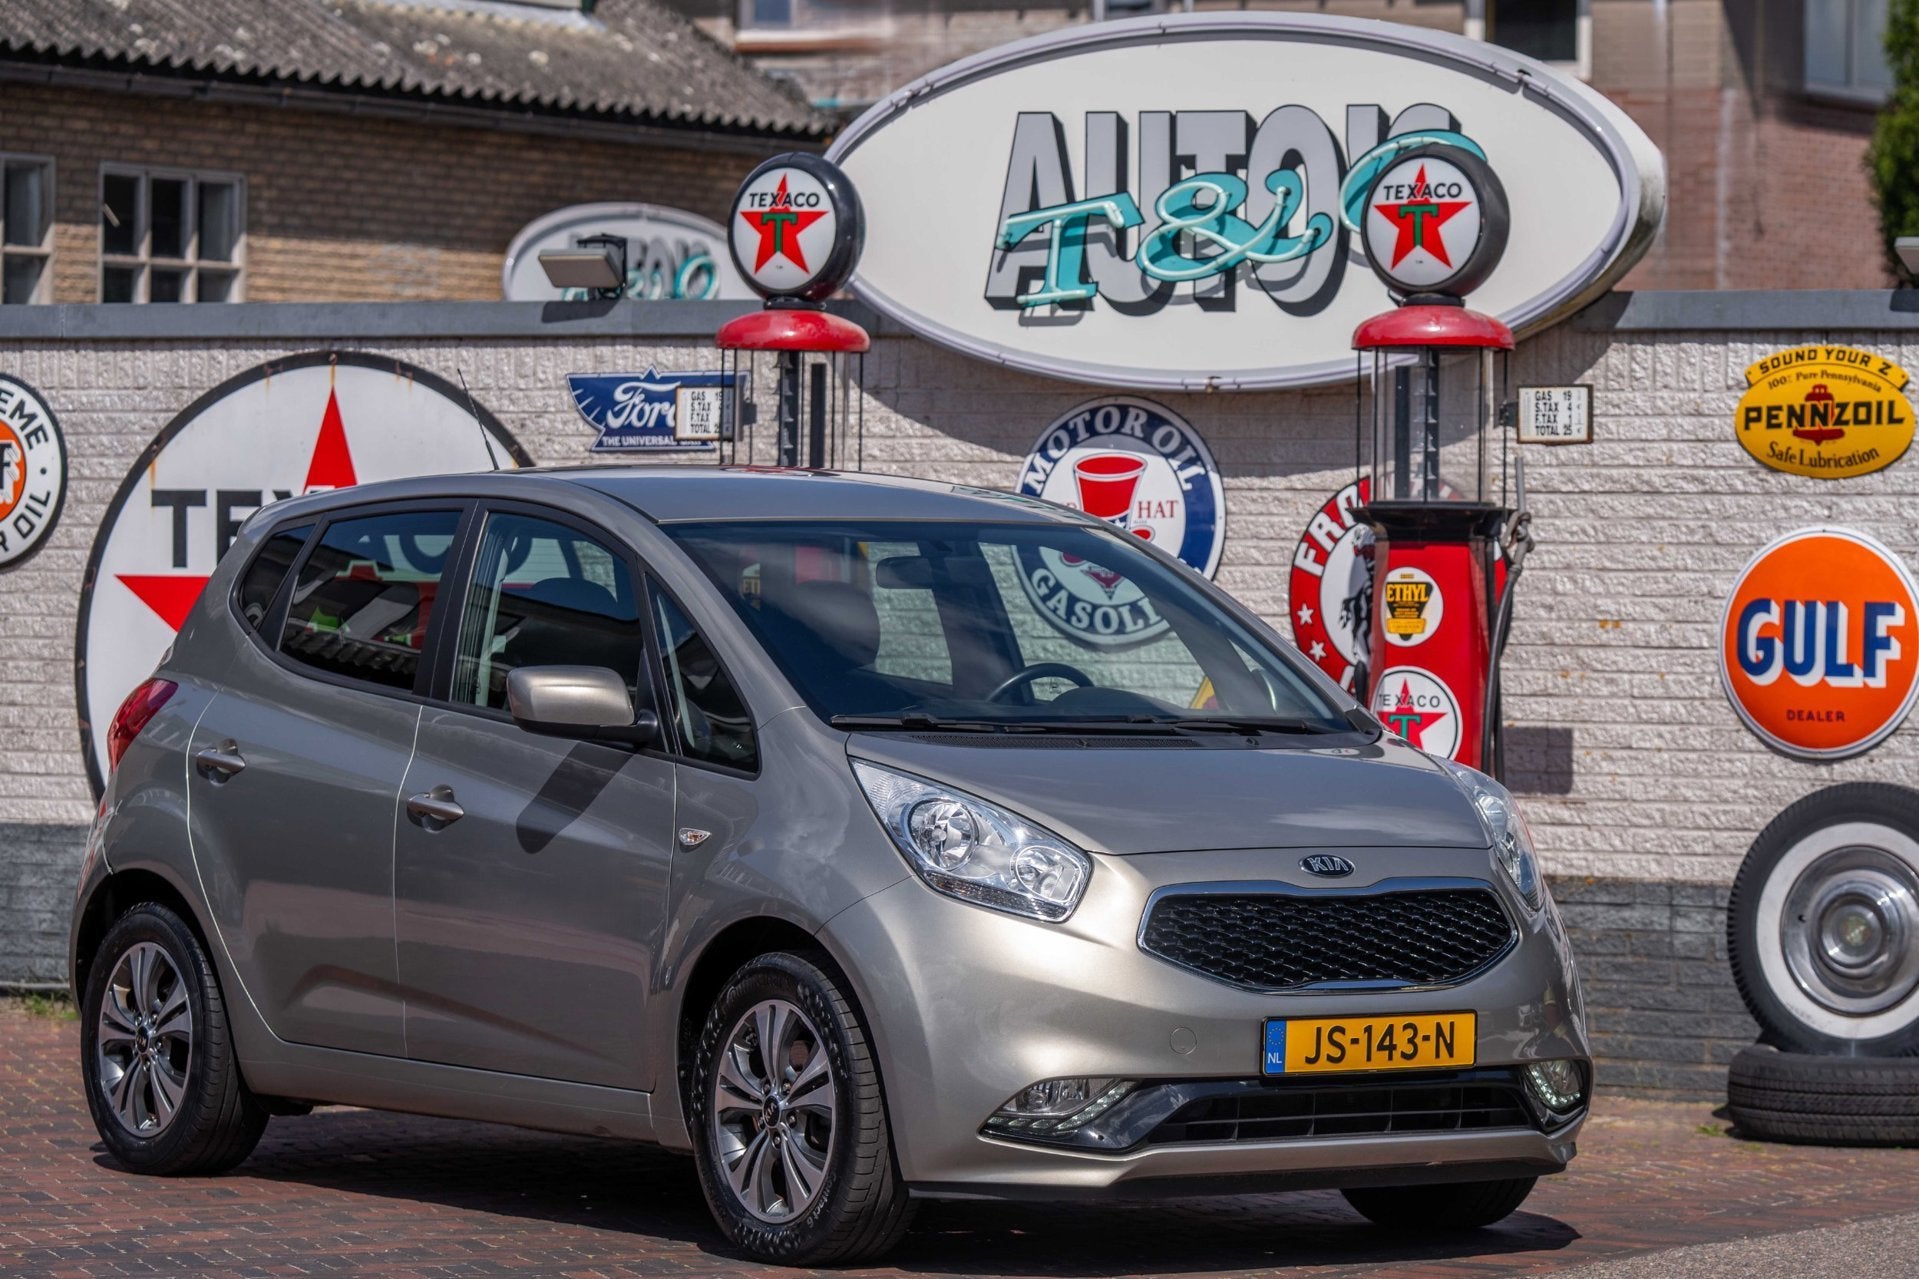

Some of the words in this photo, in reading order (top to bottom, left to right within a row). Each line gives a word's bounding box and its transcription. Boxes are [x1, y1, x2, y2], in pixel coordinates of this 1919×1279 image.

[1383, 182, 1463, 200] TEXACO
[749, 192, 820, 208] TEXACO
[1759, 349, 1818, 374] SOUND
[1825, 348, 1871, 367] YOUR
[1878, 362, 1893, 376] Z
[1796, 372, 1819, 382] Pure
[1821, 370, 1882, 393] Pennsylvania
[691, 391, 706, 401] GAS
[1535, 390, 1552, 401] GAS
[1563, 390, 1572, 401] 19
[1535, 402, 1559, 412] S.TAX
[1744, 400, 1906, 430] PENNZOIL
[1535, 413, 1558, 424] F.TAX
[690, 424, 711, 434] TOTAL
[1535, 425, 1559, 436] TOTAL
[1563, 424, 1573, 436] 25
[602, 436, 621, 447] THE
[622, 435, 677, 447] UNIVERSAL
[1024, 406, 1148, 494] MOTOR
[1153, 425, 1206, 491] OIL
[1767, 441, 1797, 465] Safe
[1800, 448, 1880, 469] Lubrication
[13, 490, 51, 539] OIL
[1137, 500, 1179, 519] HAT
[1386, 583, 1429, 603] ETHYL
[1737, 597, 1905, 688] GULF
[1786, 709, 1846, 722] DEALER
[1307, 856, 1350, 872] KIA
[1304, 1020, 1456, 1065] JS-143-N
[1267, 1052, 1283, 1065] NL
